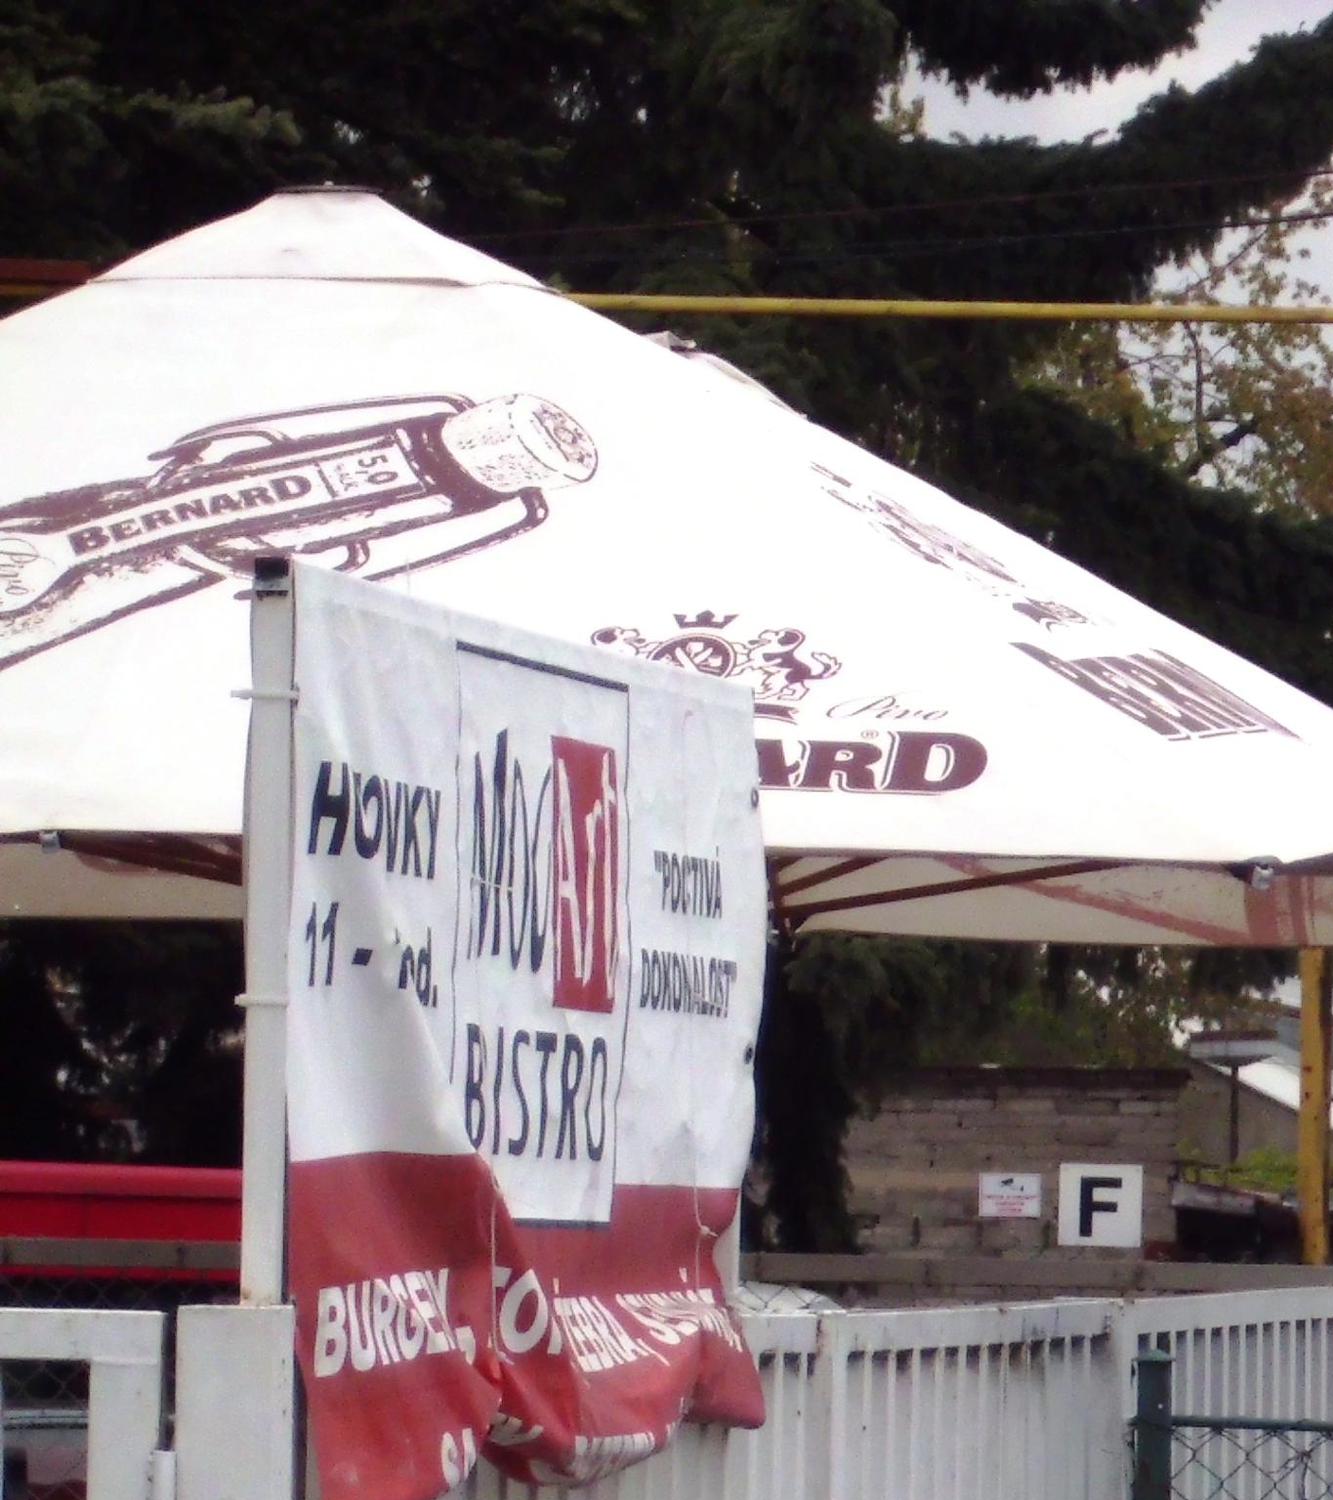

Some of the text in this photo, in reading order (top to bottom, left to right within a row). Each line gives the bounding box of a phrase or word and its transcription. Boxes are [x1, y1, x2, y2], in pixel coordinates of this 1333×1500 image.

[67, 475, 312, 556] BERNARD
[465, 1022, 608, 1162] BISTRO
[1079, 1175, 1122, 1237] F
